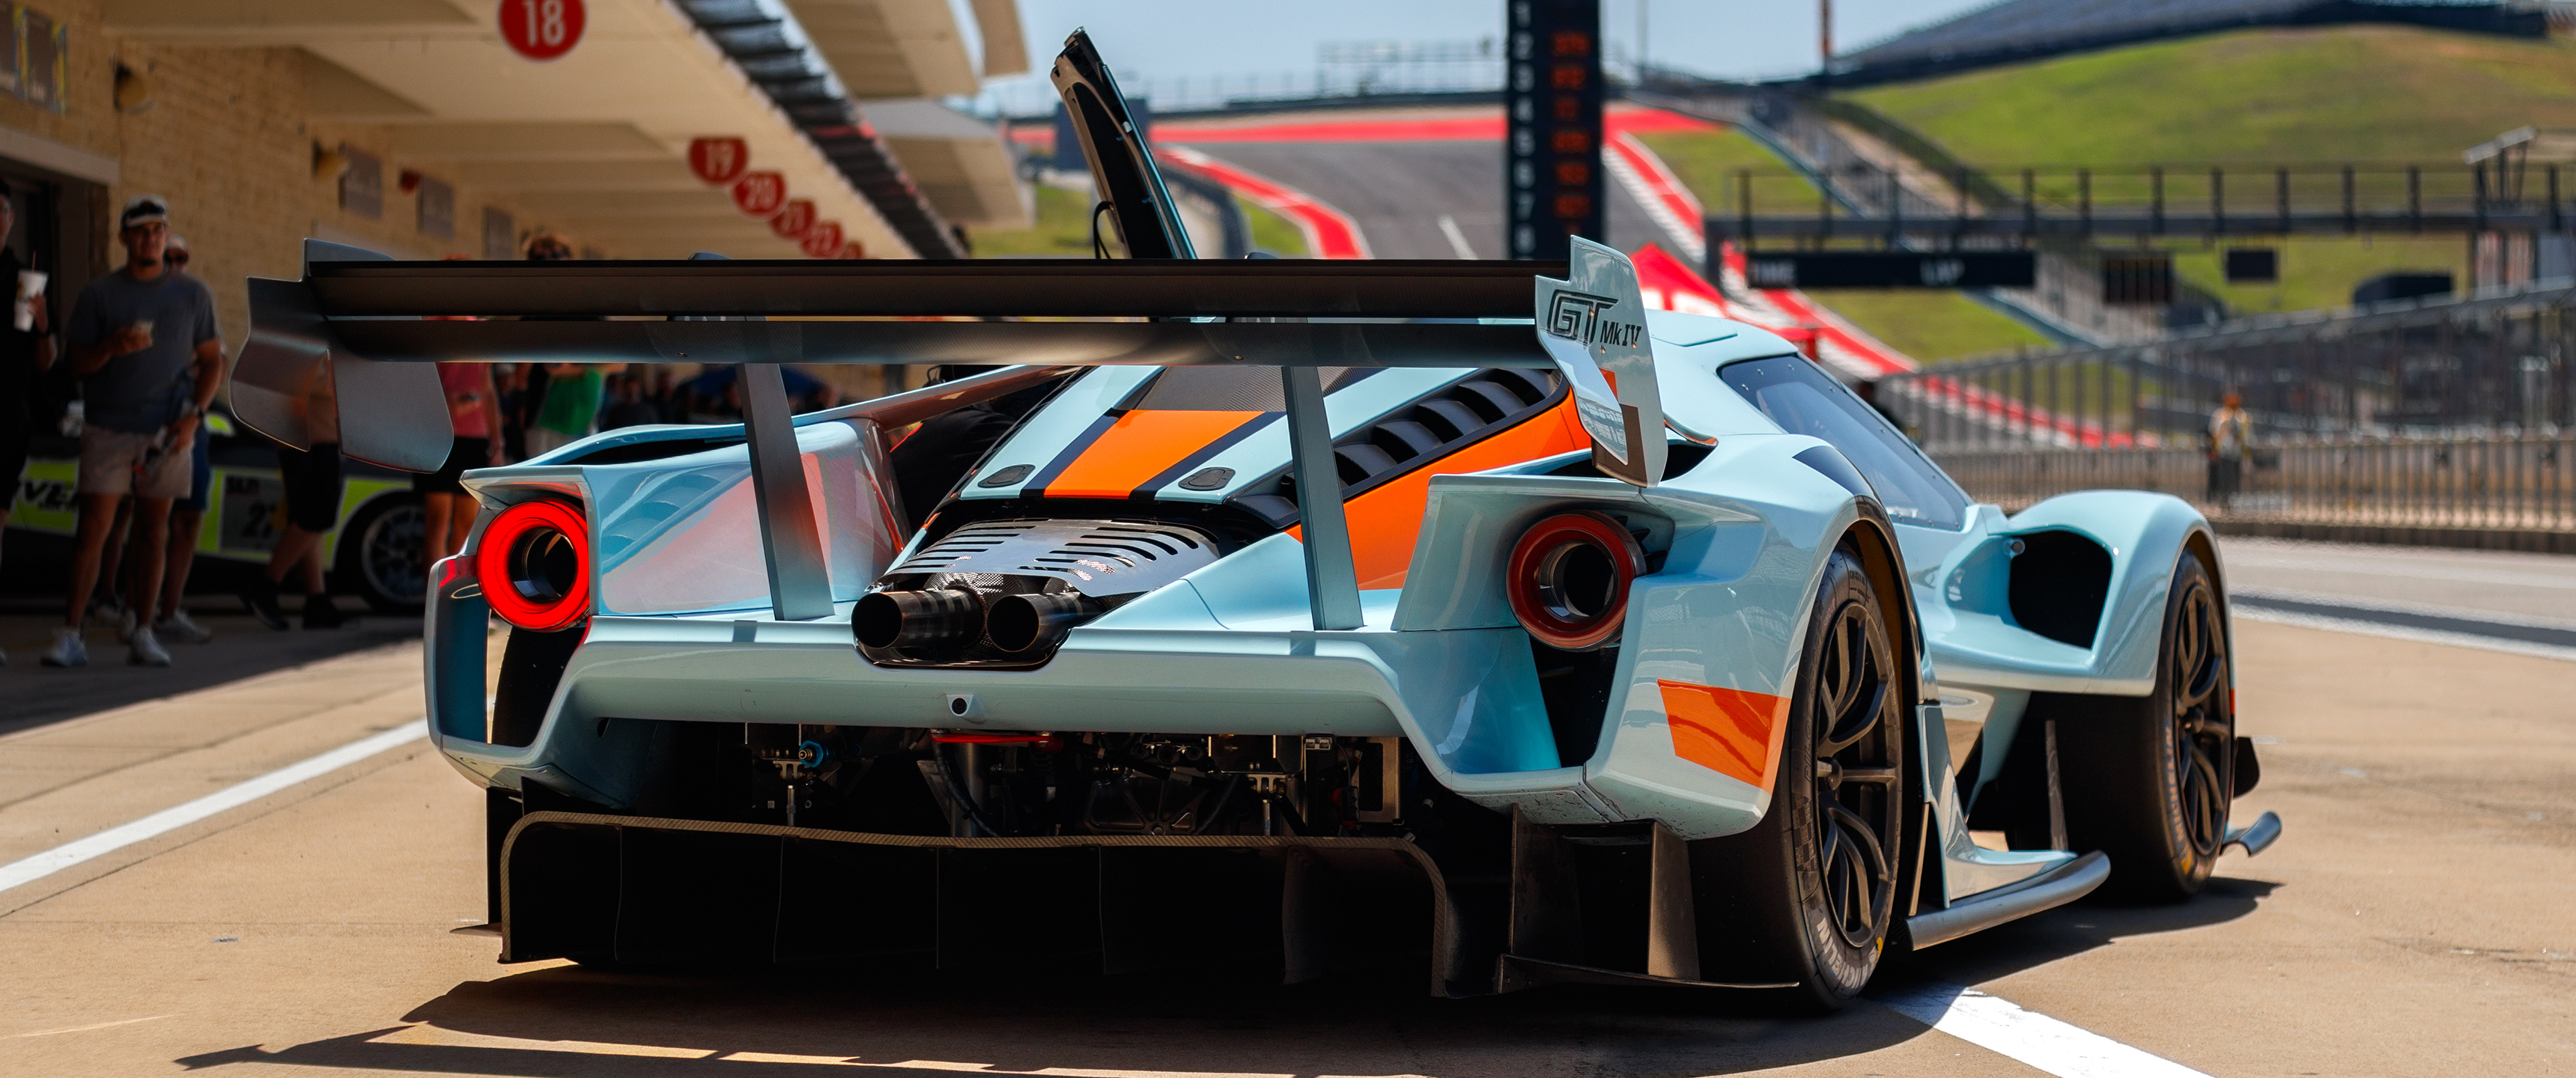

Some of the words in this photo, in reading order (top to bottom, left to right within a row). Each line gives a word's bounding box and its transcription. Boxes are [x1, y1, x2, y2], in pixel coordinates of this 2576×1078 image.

[522, 0, 565, 46] 18
[705, 141, 736, 177] 19
[744, 177, 778, 209] 20
[1546, 289, 1619, 347] GT
[2165, 726, 2185, 842] MICHELIN
[1816, 916, 1871, 989] MICHELIN
